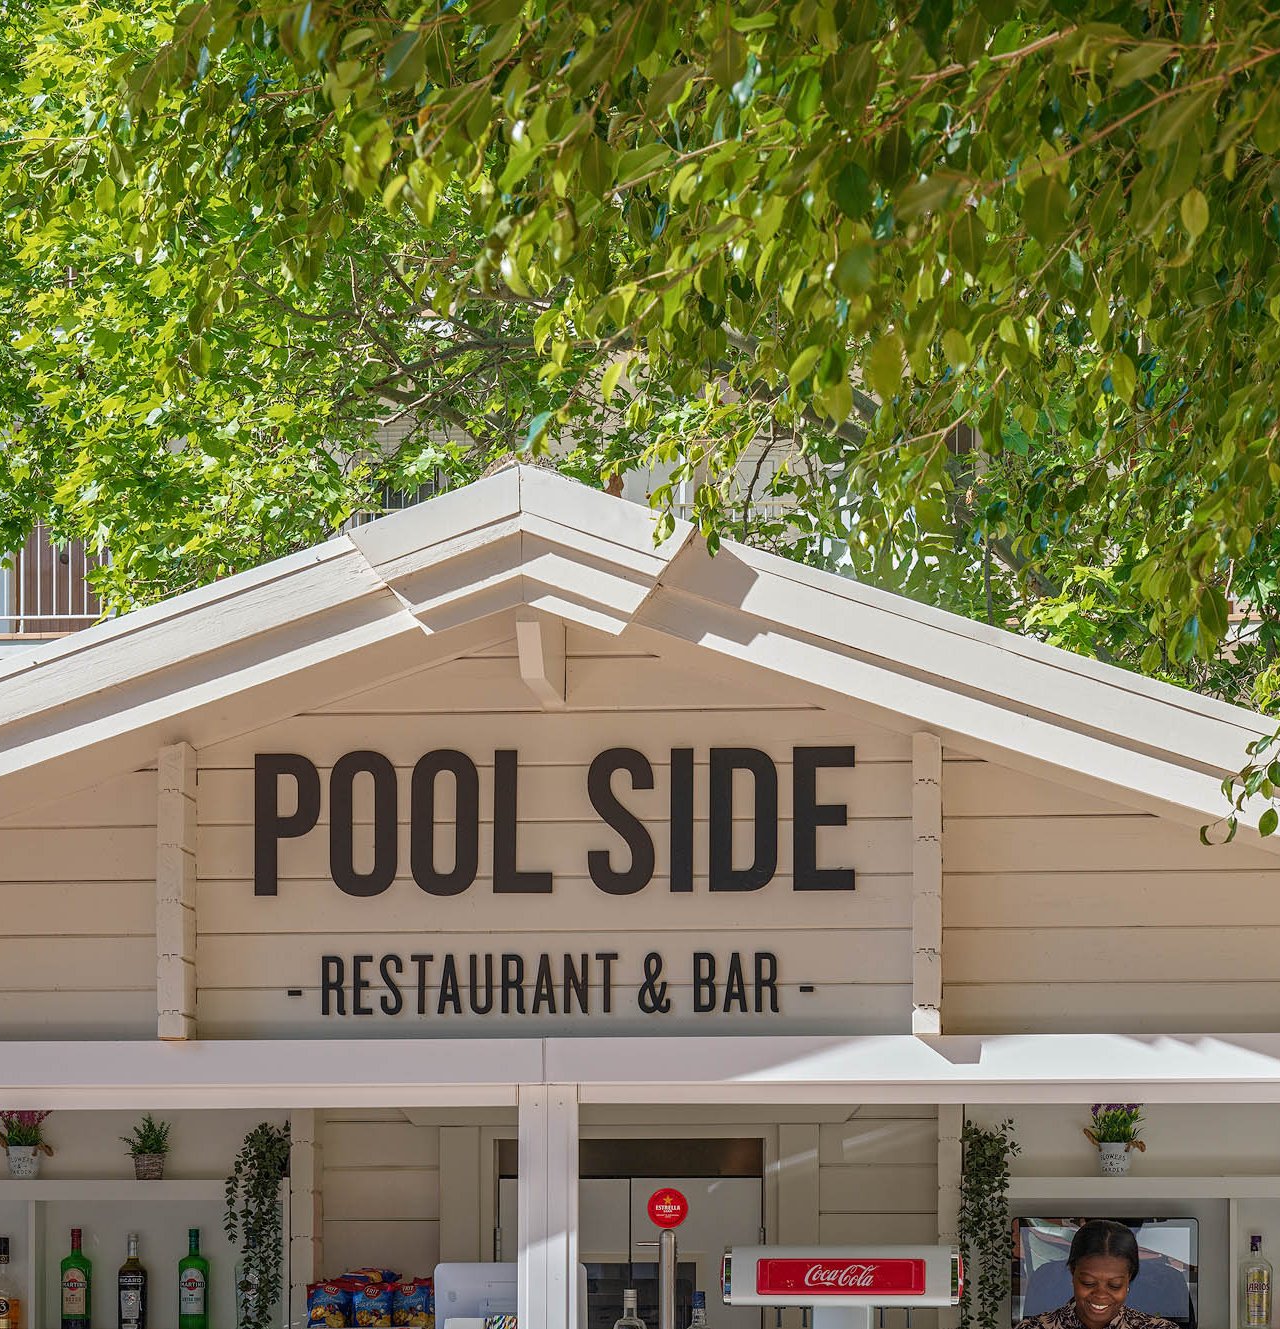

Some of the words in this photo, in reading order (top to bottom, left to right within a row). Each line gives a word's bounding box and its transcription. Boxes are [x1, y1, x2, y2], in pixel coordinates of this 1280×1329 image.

[254, 749, 553, 897] POOL
[587, 745, 856, 896] SIDE
[321, 952, 619, 1016] RESTAURANT
[637, 952, 671, 1014] &
[693, 952, 780, 1013] BAR
[118, 1276, 142, 1284] RICARD
[804, 1263, 880, 1287] Coca-Cola
[63, 1281, 87, 1289] MARTINI
[365, 1287, 380, 1297] FRIT
